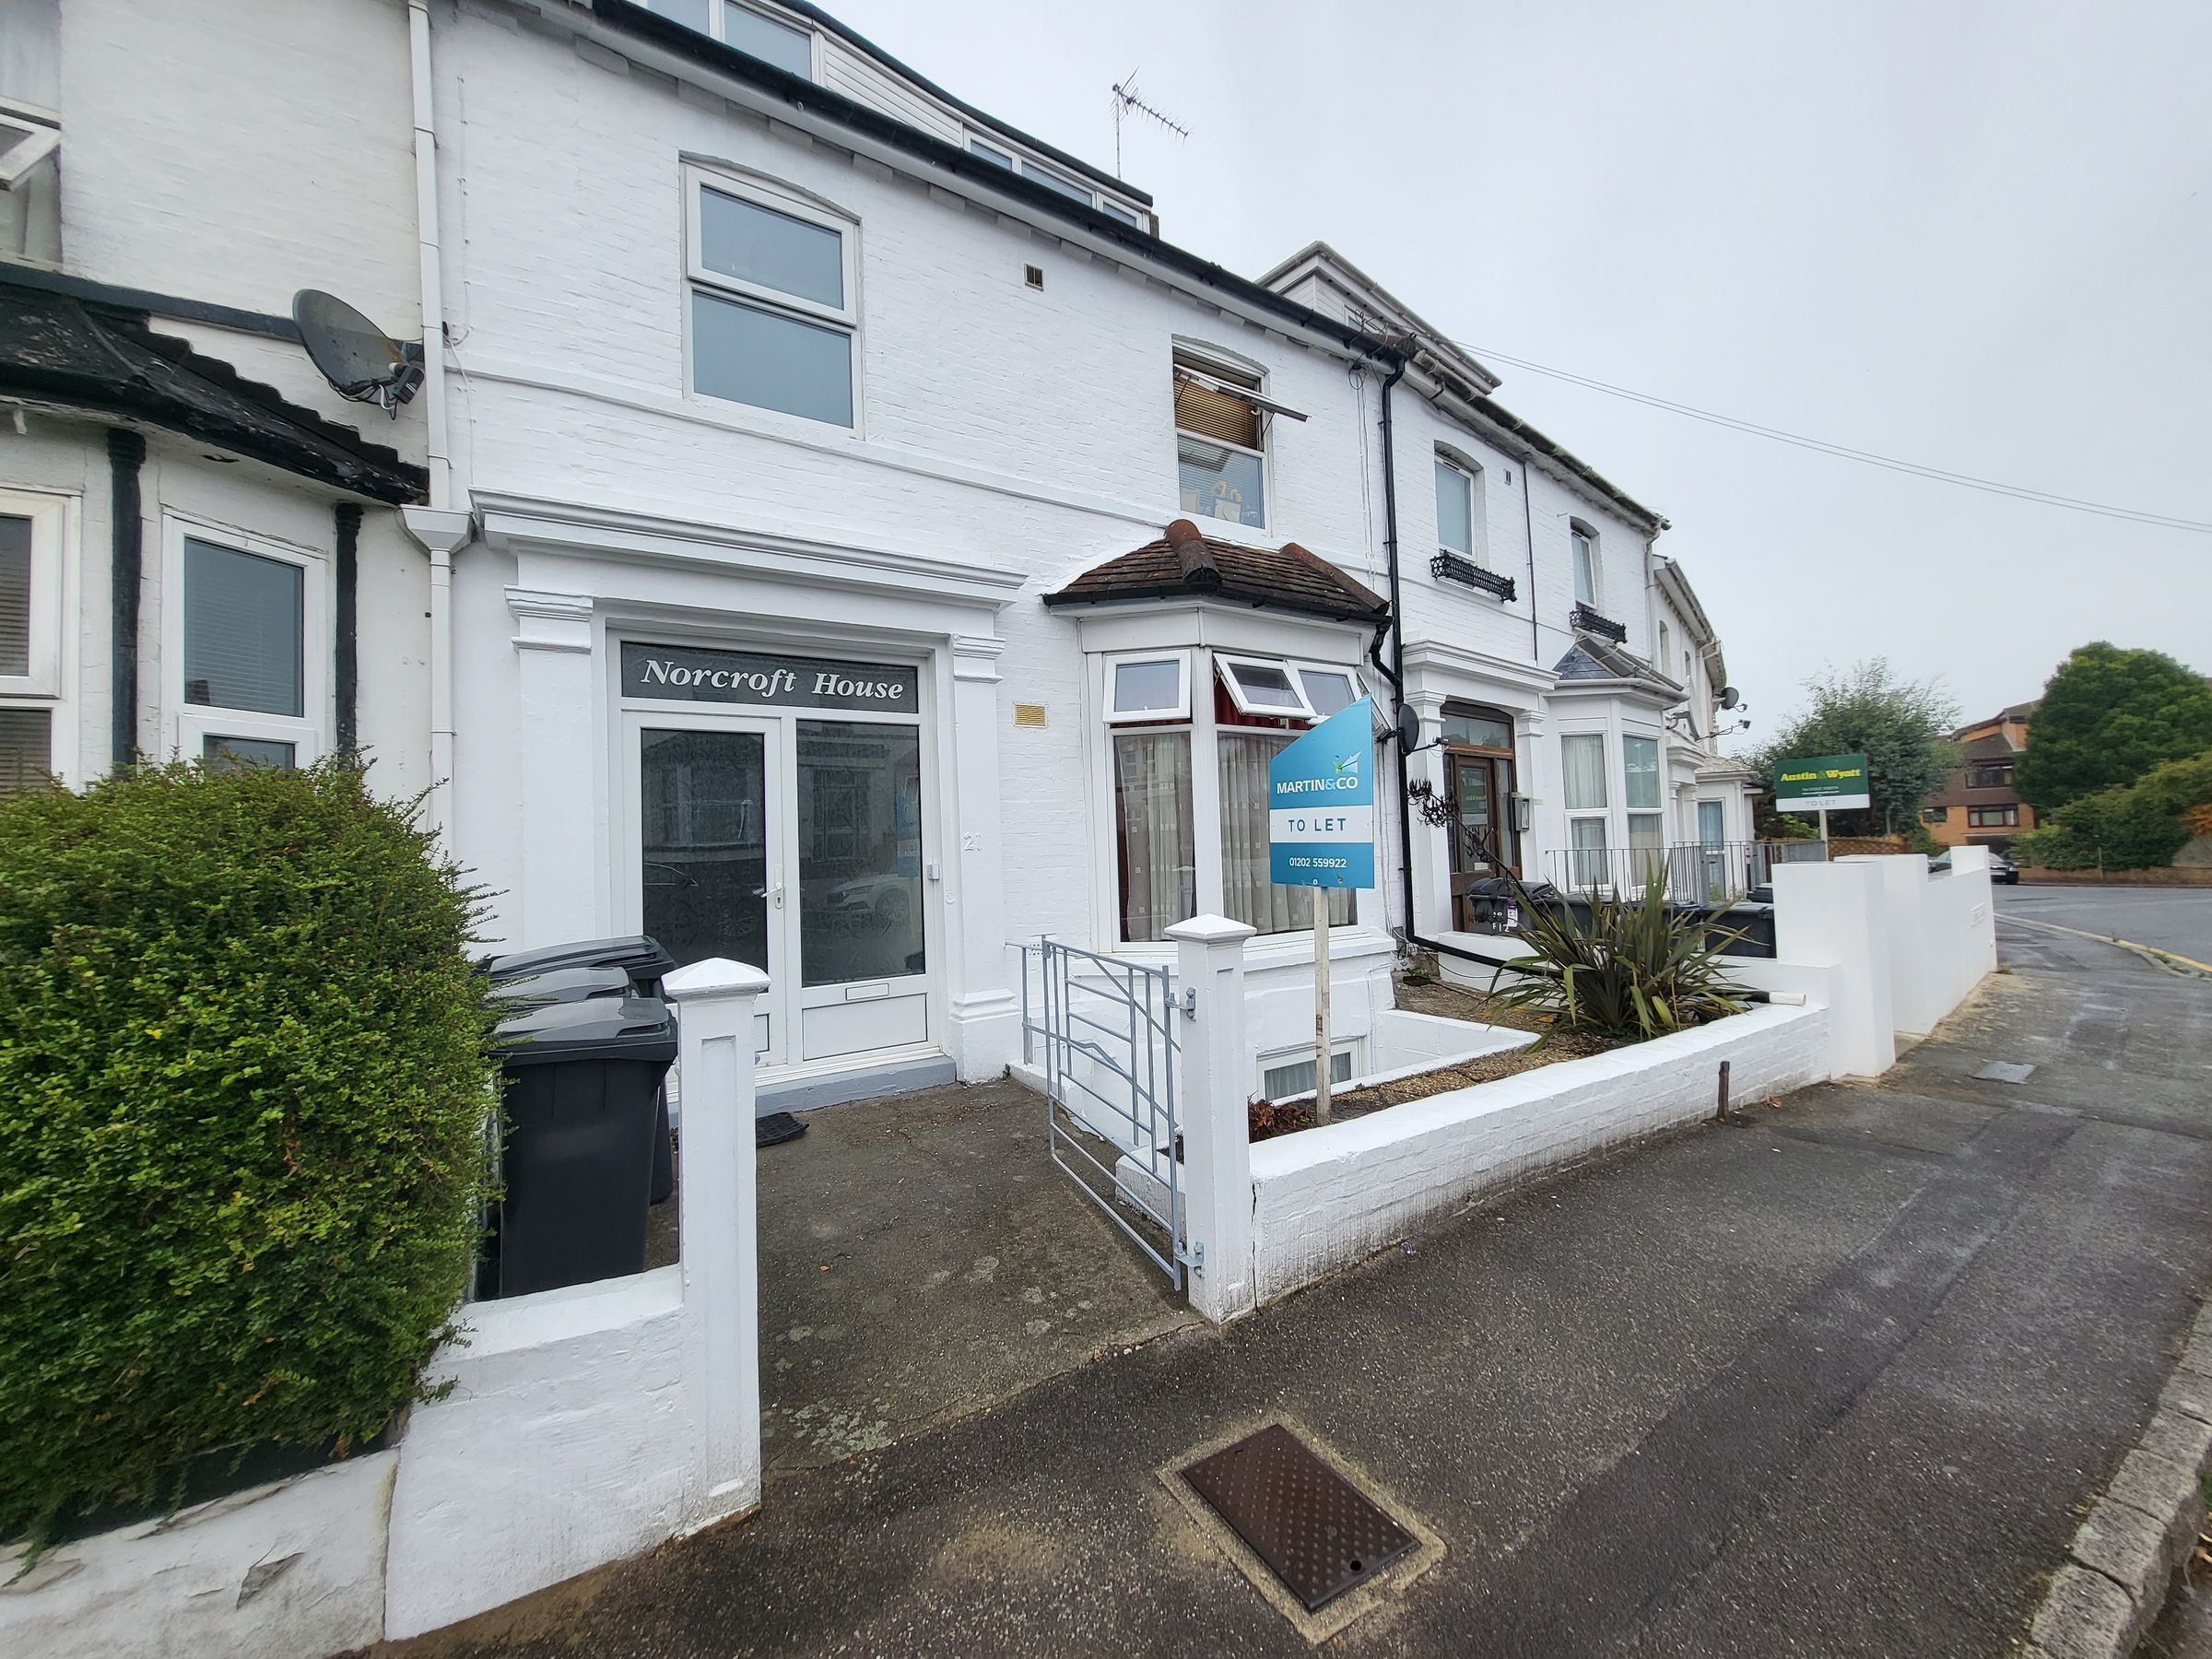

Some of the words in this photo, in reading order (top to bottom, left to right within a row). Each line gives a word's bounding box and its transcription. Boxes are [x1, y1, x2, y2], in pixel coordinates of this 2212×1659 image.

[641, 660, 796, 697] Norcroft
[811, 672, 903, 700] House
[1781, 772, 1817, 782] Austin
[1825, 769, 1861, 780] Wyatt
[1277, 776, 1359, 794] MARTIN&CO
[1288, 819, 1306, 831] TO
[1314, 818, 1347, 831] LET
[1288, 857, 1311, 867] 01202
[1312, 857, 1347, 868] 559922
